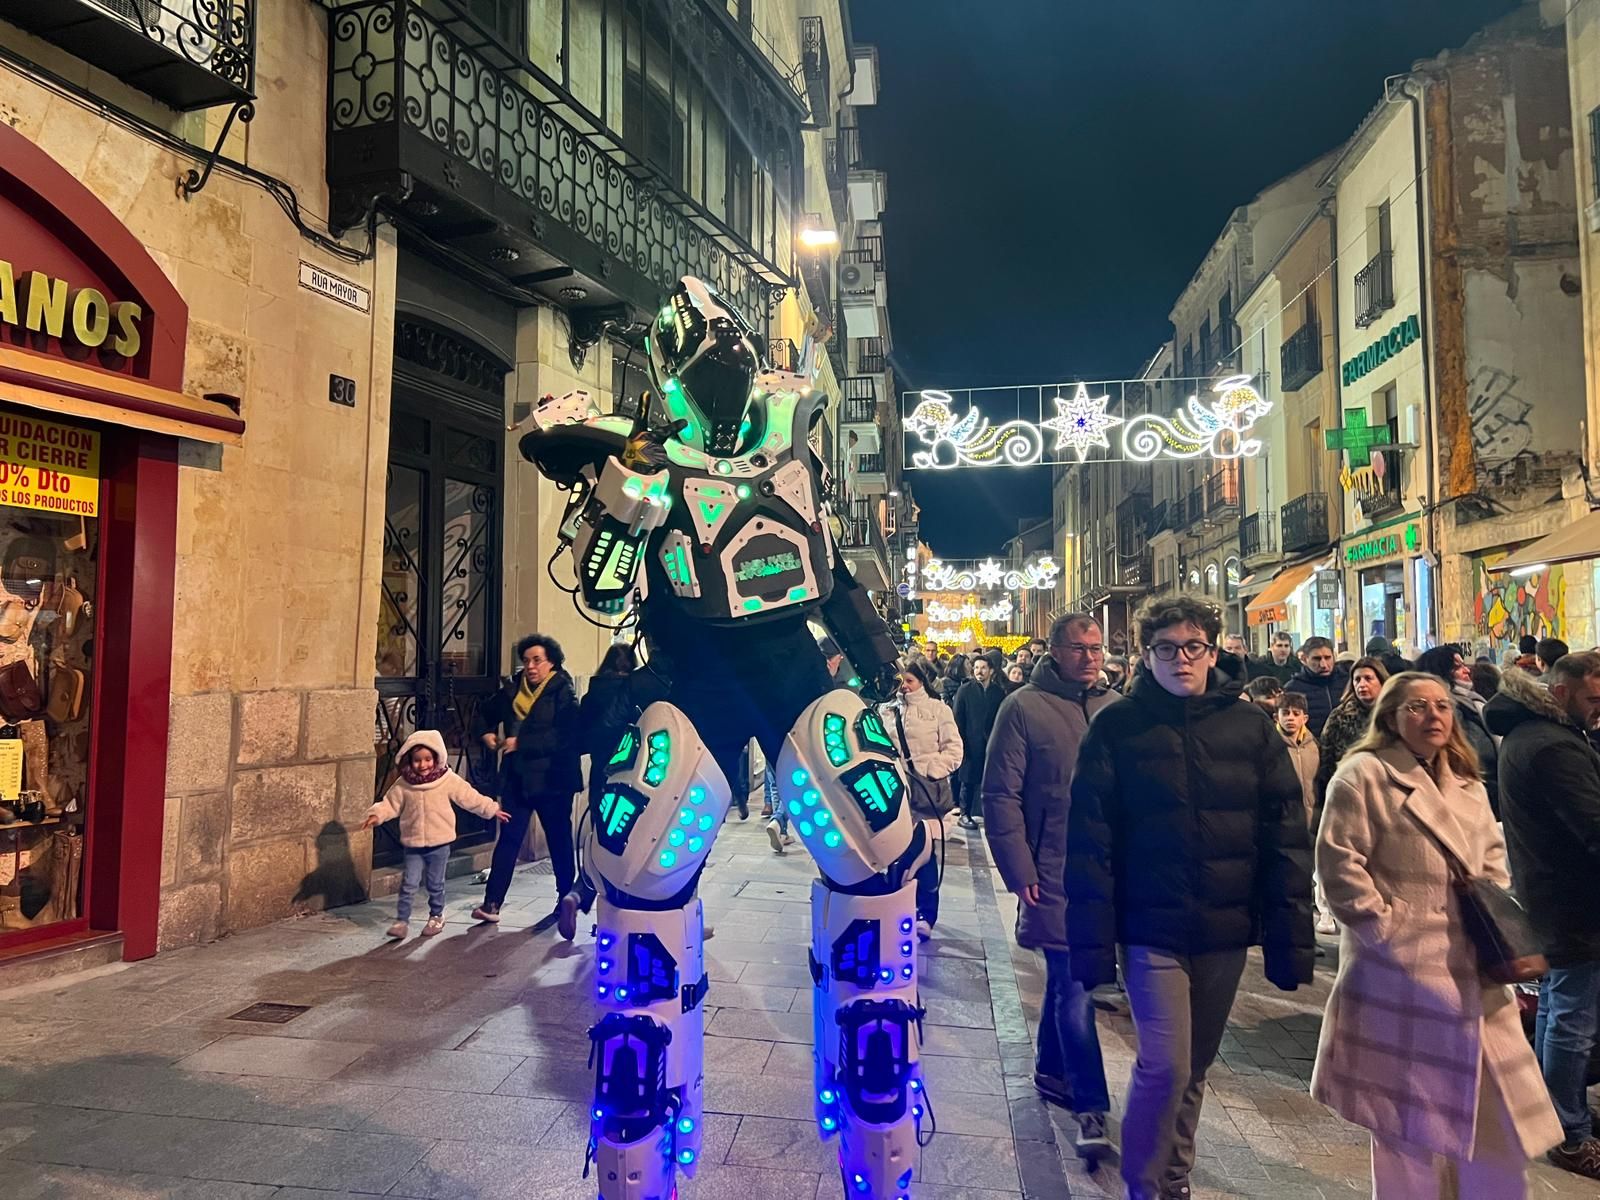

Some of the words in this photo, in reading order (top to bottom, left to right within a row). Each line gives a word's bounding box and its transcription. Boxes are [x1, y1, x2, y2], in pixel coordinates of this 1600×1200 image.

[312, 271, 328, 291] RUA
[329, 280, 358, 304] MAYOR
[1342, 314, 1421, 387] FARMACIA
[333, 378, 355, 403] 30
[16, 441, 89, 470] CIERRE
[38, 467, 71, 494] Dto
[0, 488, 9, 502] S
[11, 490, 31, 505] LOS
[34, 493, 94, 514] PRODUCTOS
[1347, 535, 1397, 562] FARMACIA
